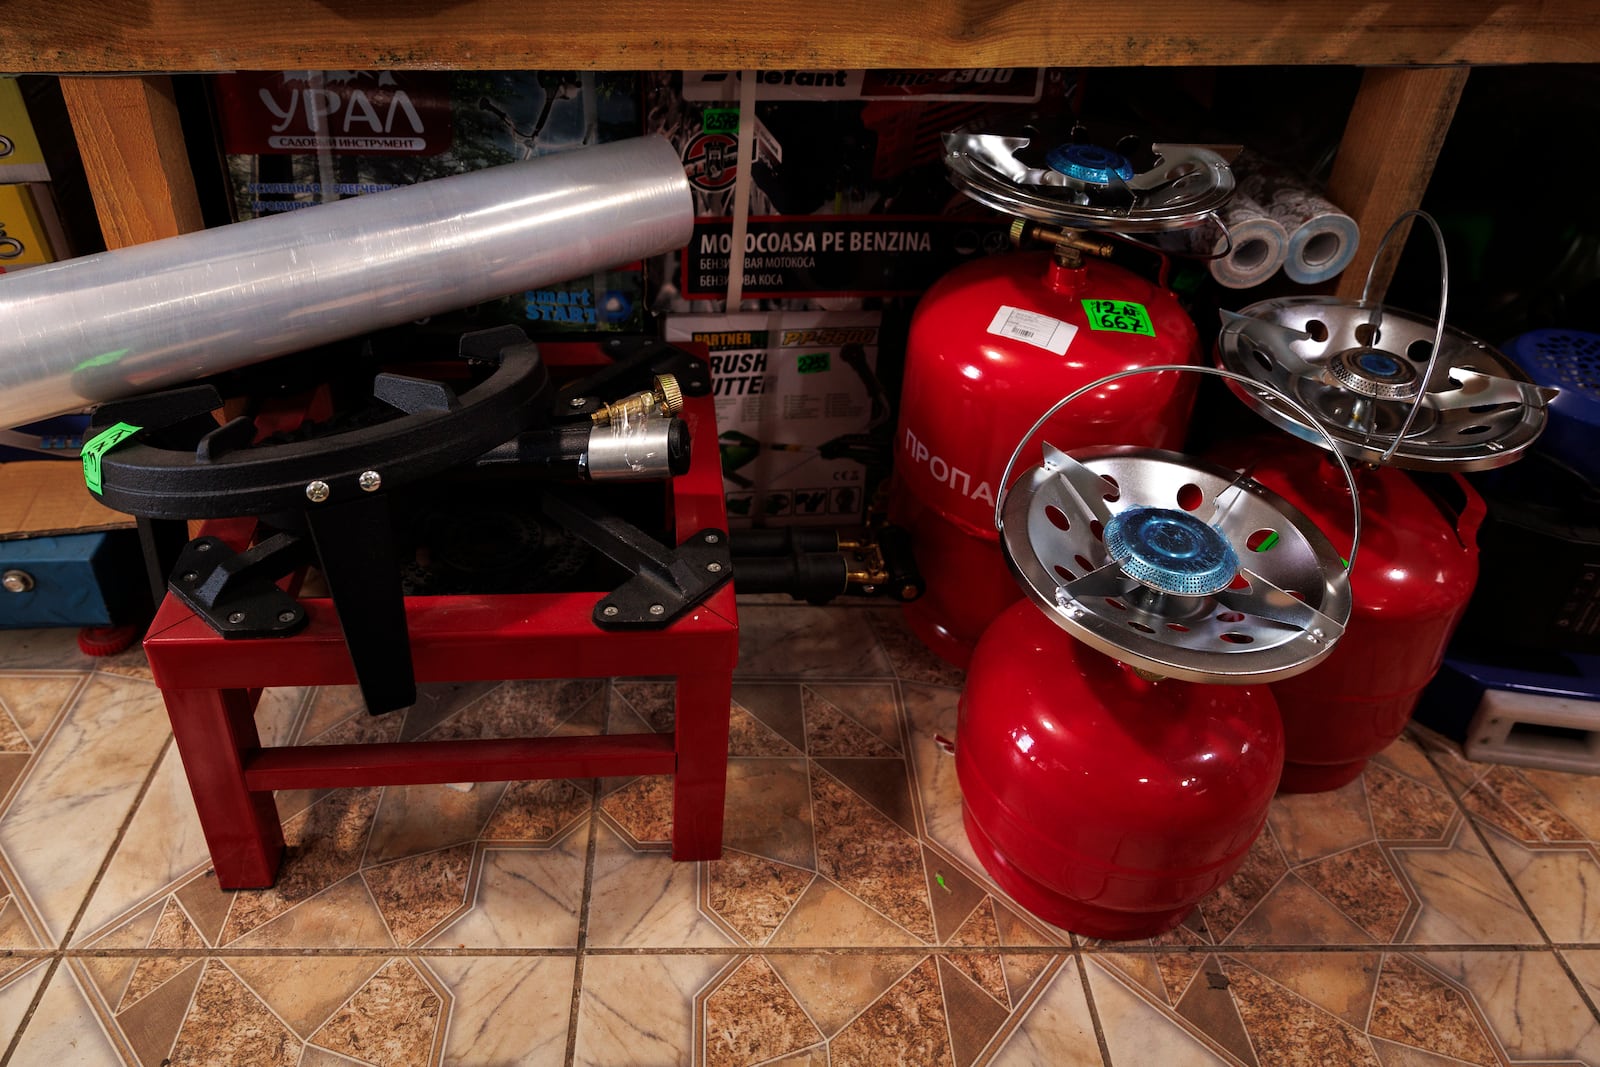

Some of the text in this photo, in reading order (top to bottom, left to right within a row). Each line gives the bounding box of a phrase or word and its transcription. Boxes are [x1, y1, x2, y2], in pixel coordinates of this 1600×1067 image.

[258, 87, 425, 134] УРАЛ
[279, 137, 415, 148] САДОВЙ ИНСТРУМЕНТ
[248, 182, 320, 194] УСИЛЕННАЯ
[701, 231, 932, 254] MOOCOASA PE BENZINA
[699, 256, 816, 270] БЕНЗИВАЯ МОТОКОСА
[758, 273, 783, 286] КОСА
[1101, 314, 1144, 332] 667
[693, 332, 751, 347] PARTNER
[710, 353, 767, 375] RUSH
[711, 375, 770, 397] UTTE
[905, 427, 1008, 509] ПРОПА
